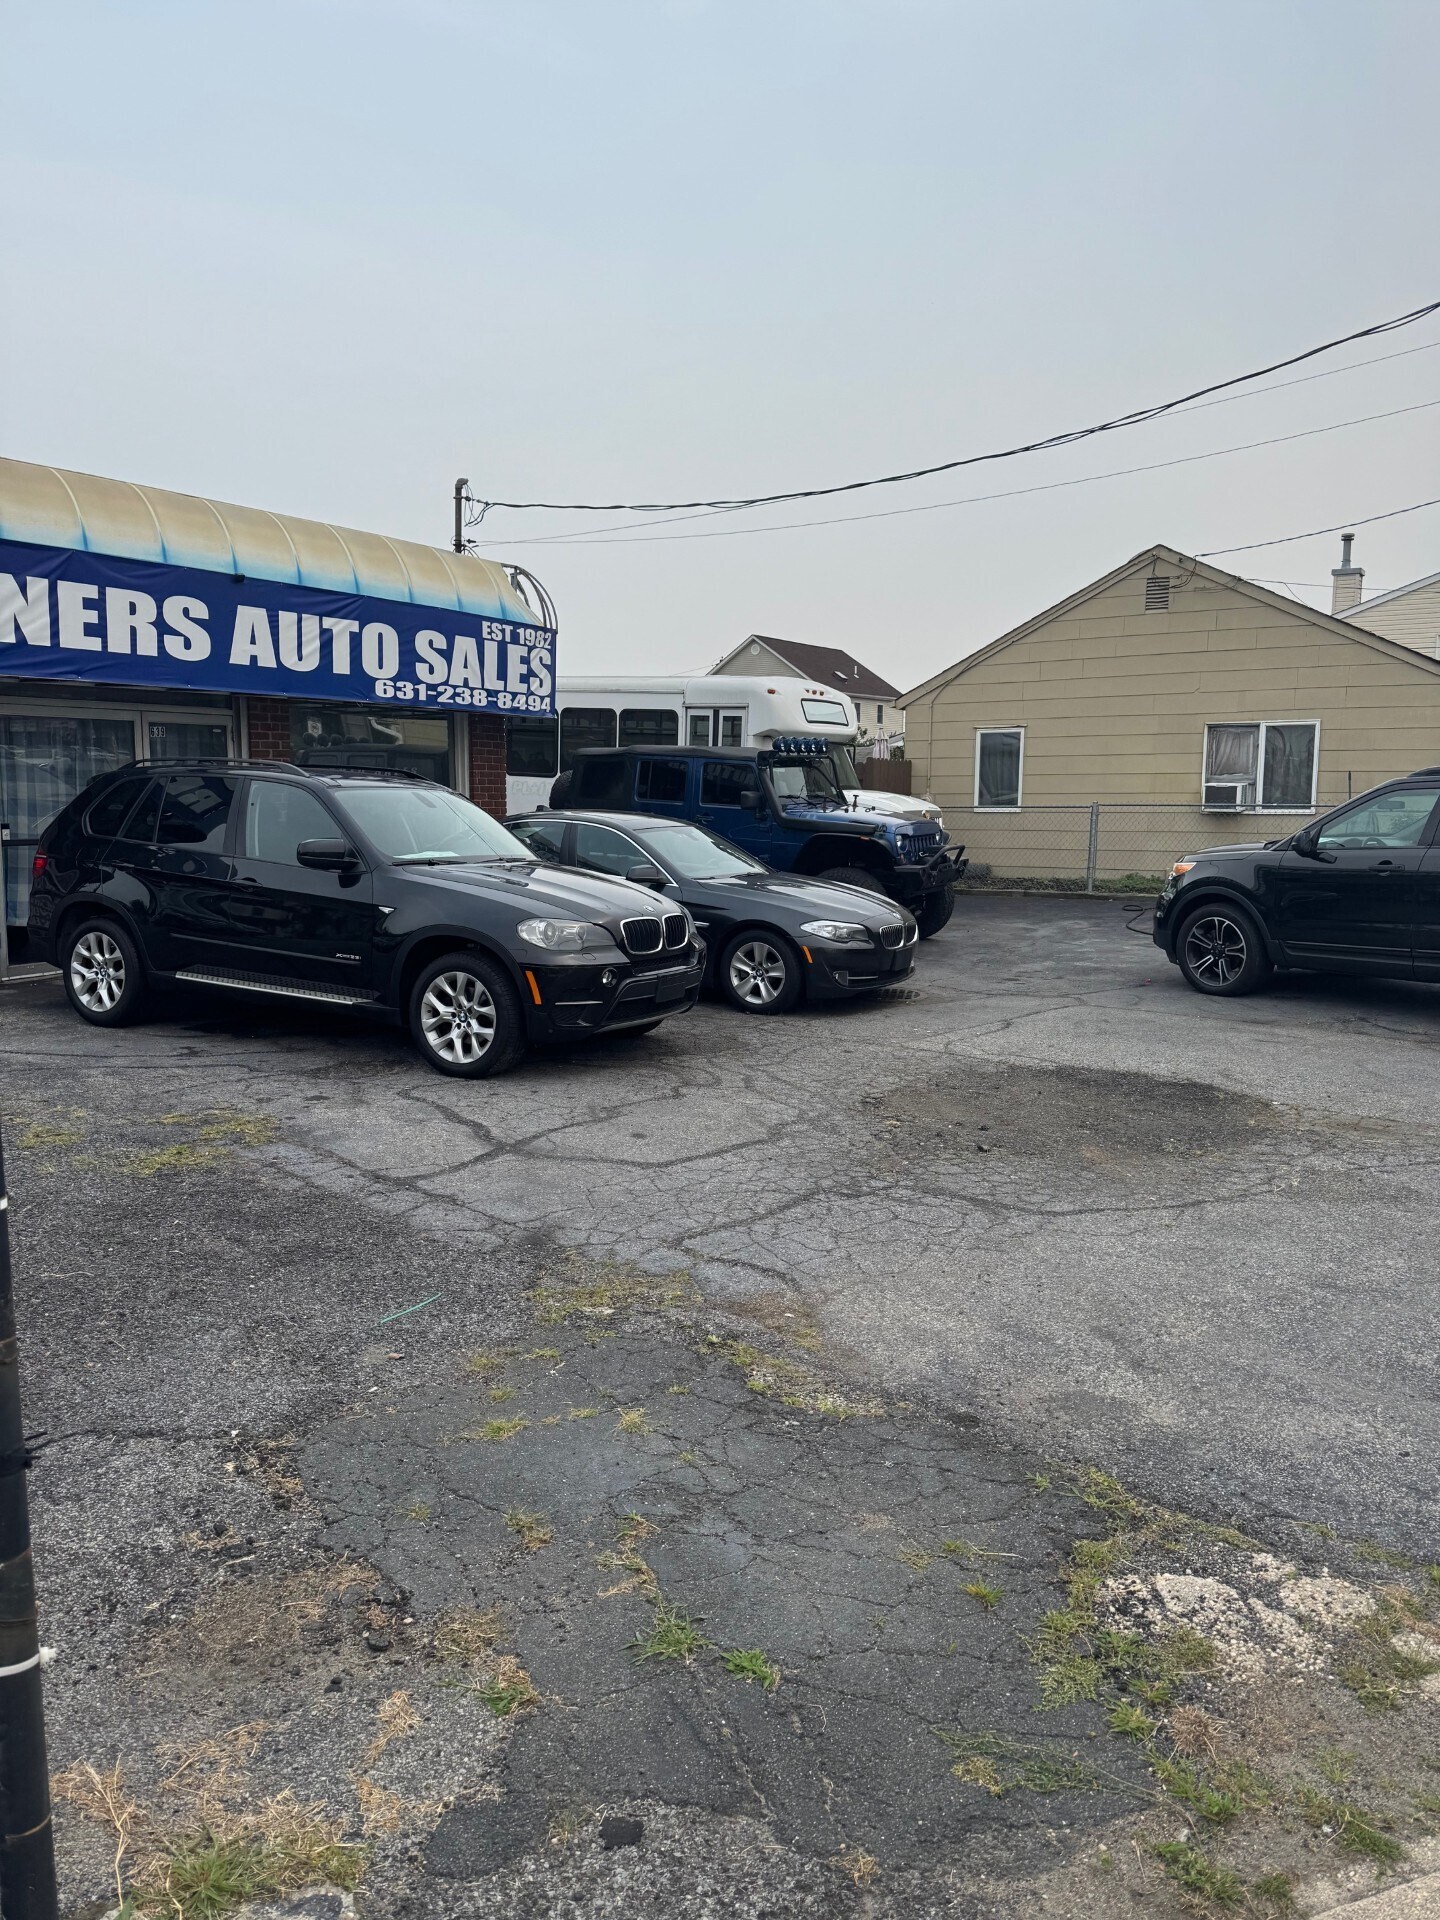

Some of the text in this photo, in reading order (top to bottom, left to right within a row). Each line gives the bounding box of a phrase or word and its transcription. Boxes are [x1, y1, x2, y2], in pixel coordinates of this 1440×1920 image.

[0, 573, 552, 697] NERS AUTO SALES
[481, 621, 552, 649] EST 1982
[375, 680, 551, 713] 631-238-8494
[150, 727, 166, 738] 639
